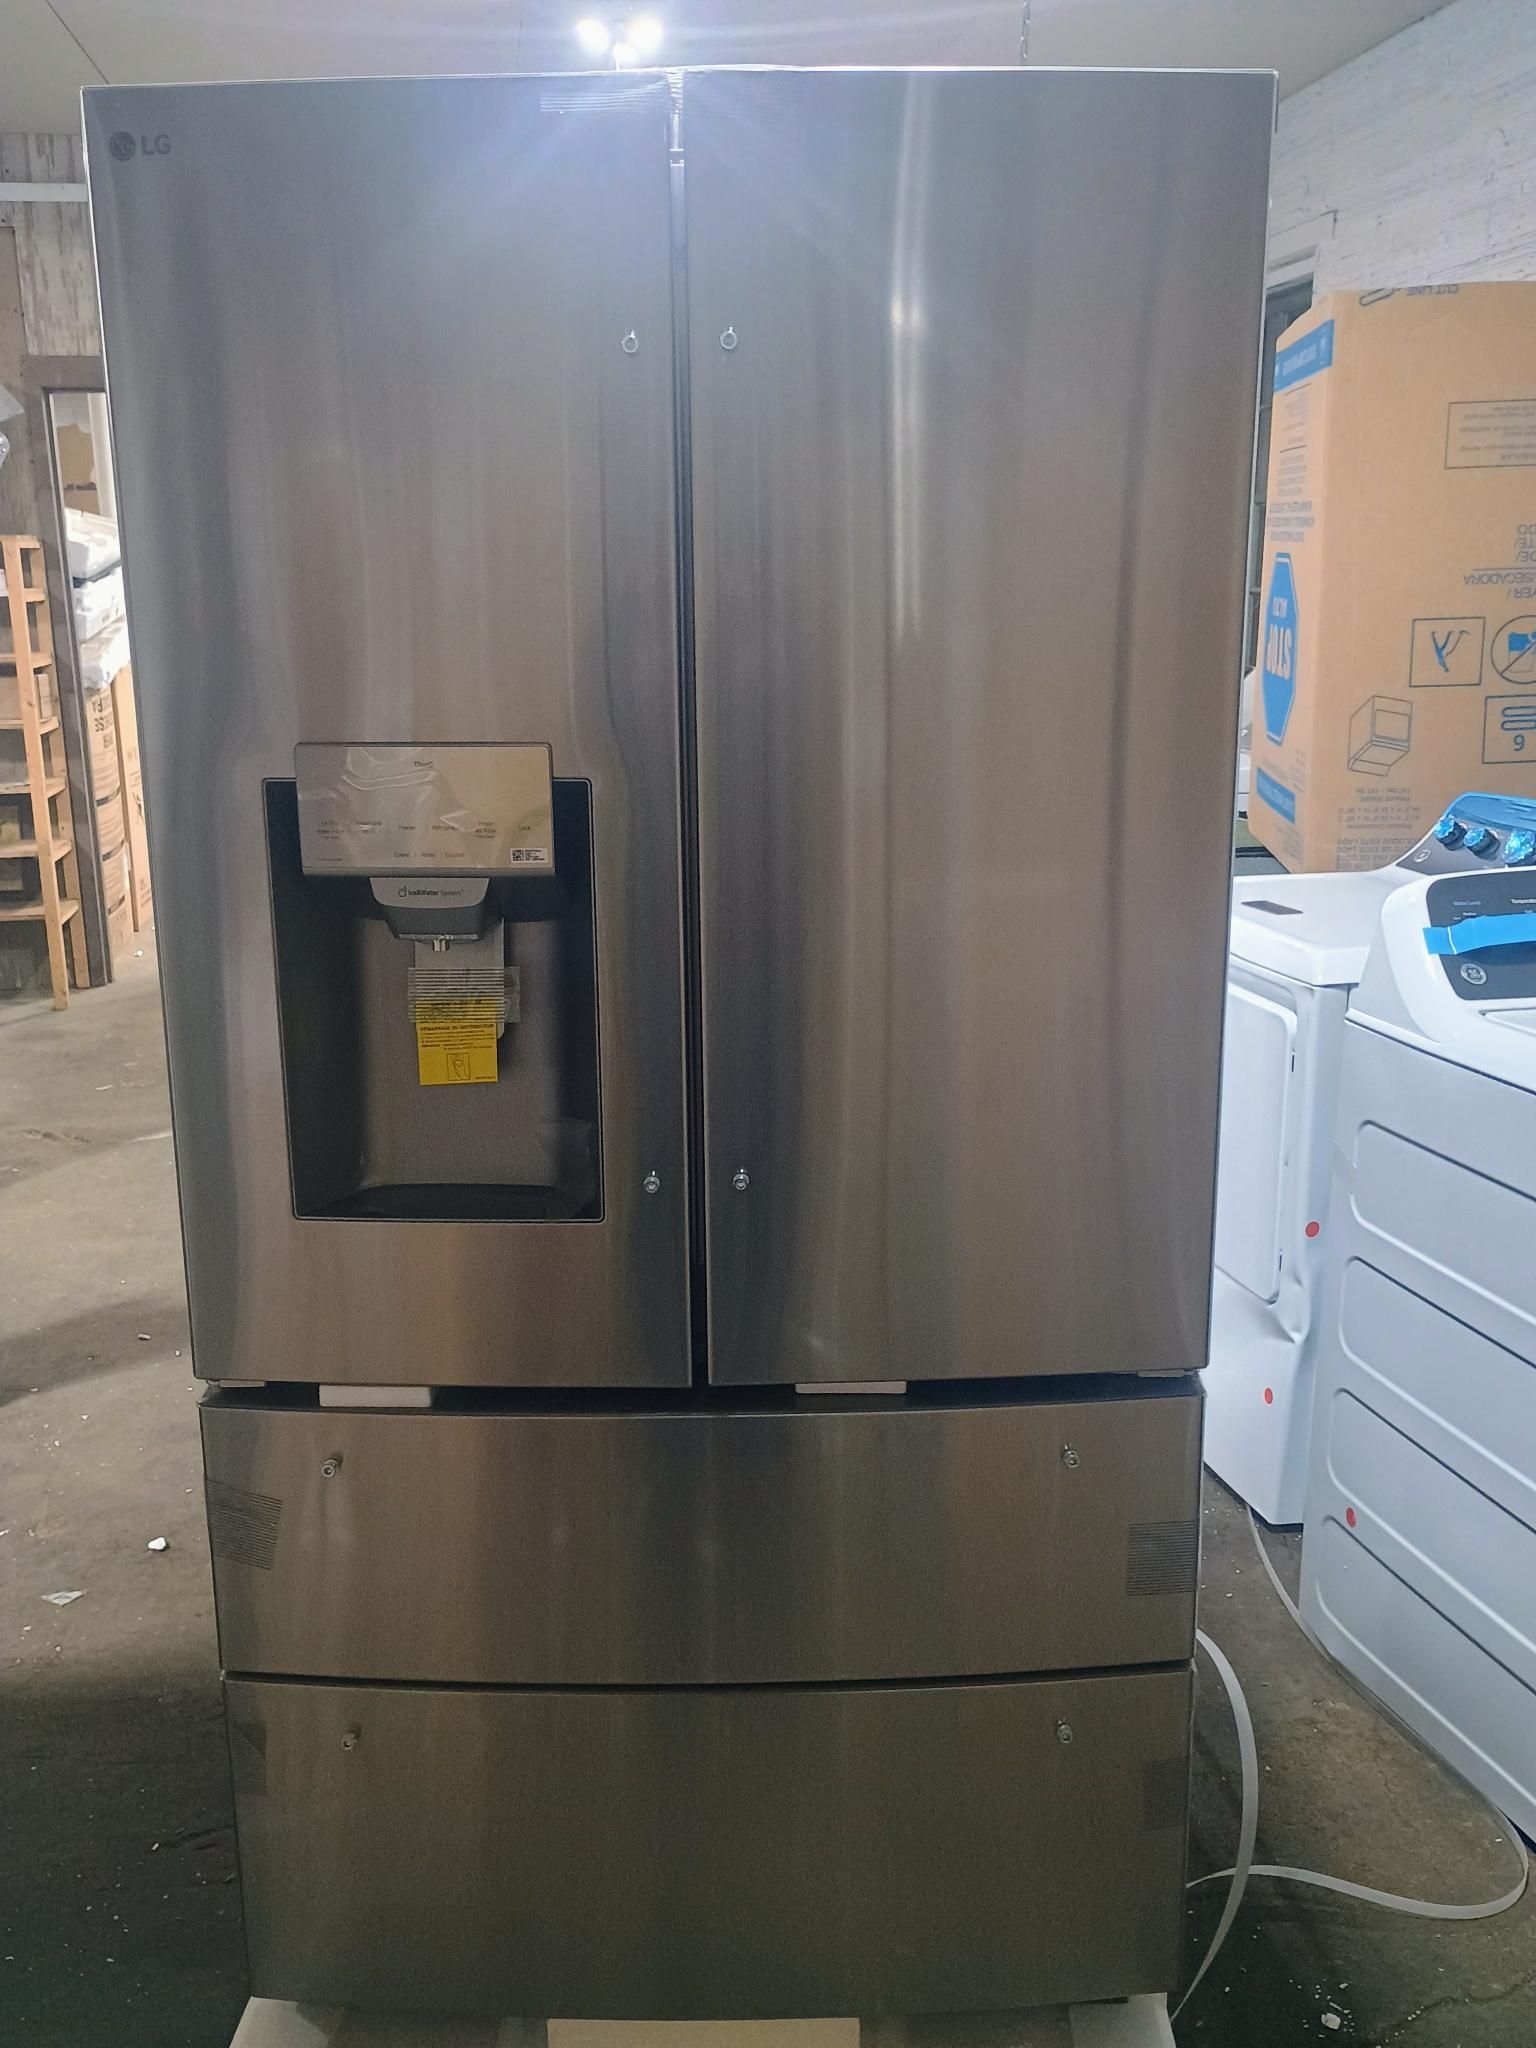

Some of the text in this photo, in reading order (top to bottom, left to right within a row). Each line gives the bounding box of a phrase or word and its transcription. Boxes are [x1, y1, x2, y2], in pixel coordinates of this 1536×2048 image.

[140, 134, 171, 156] LG
[1407, 284, 1460, 296] CUT LINE
[1266, 624, 1292, 680] STOP
[1513, 735, 1525, 751] 6
